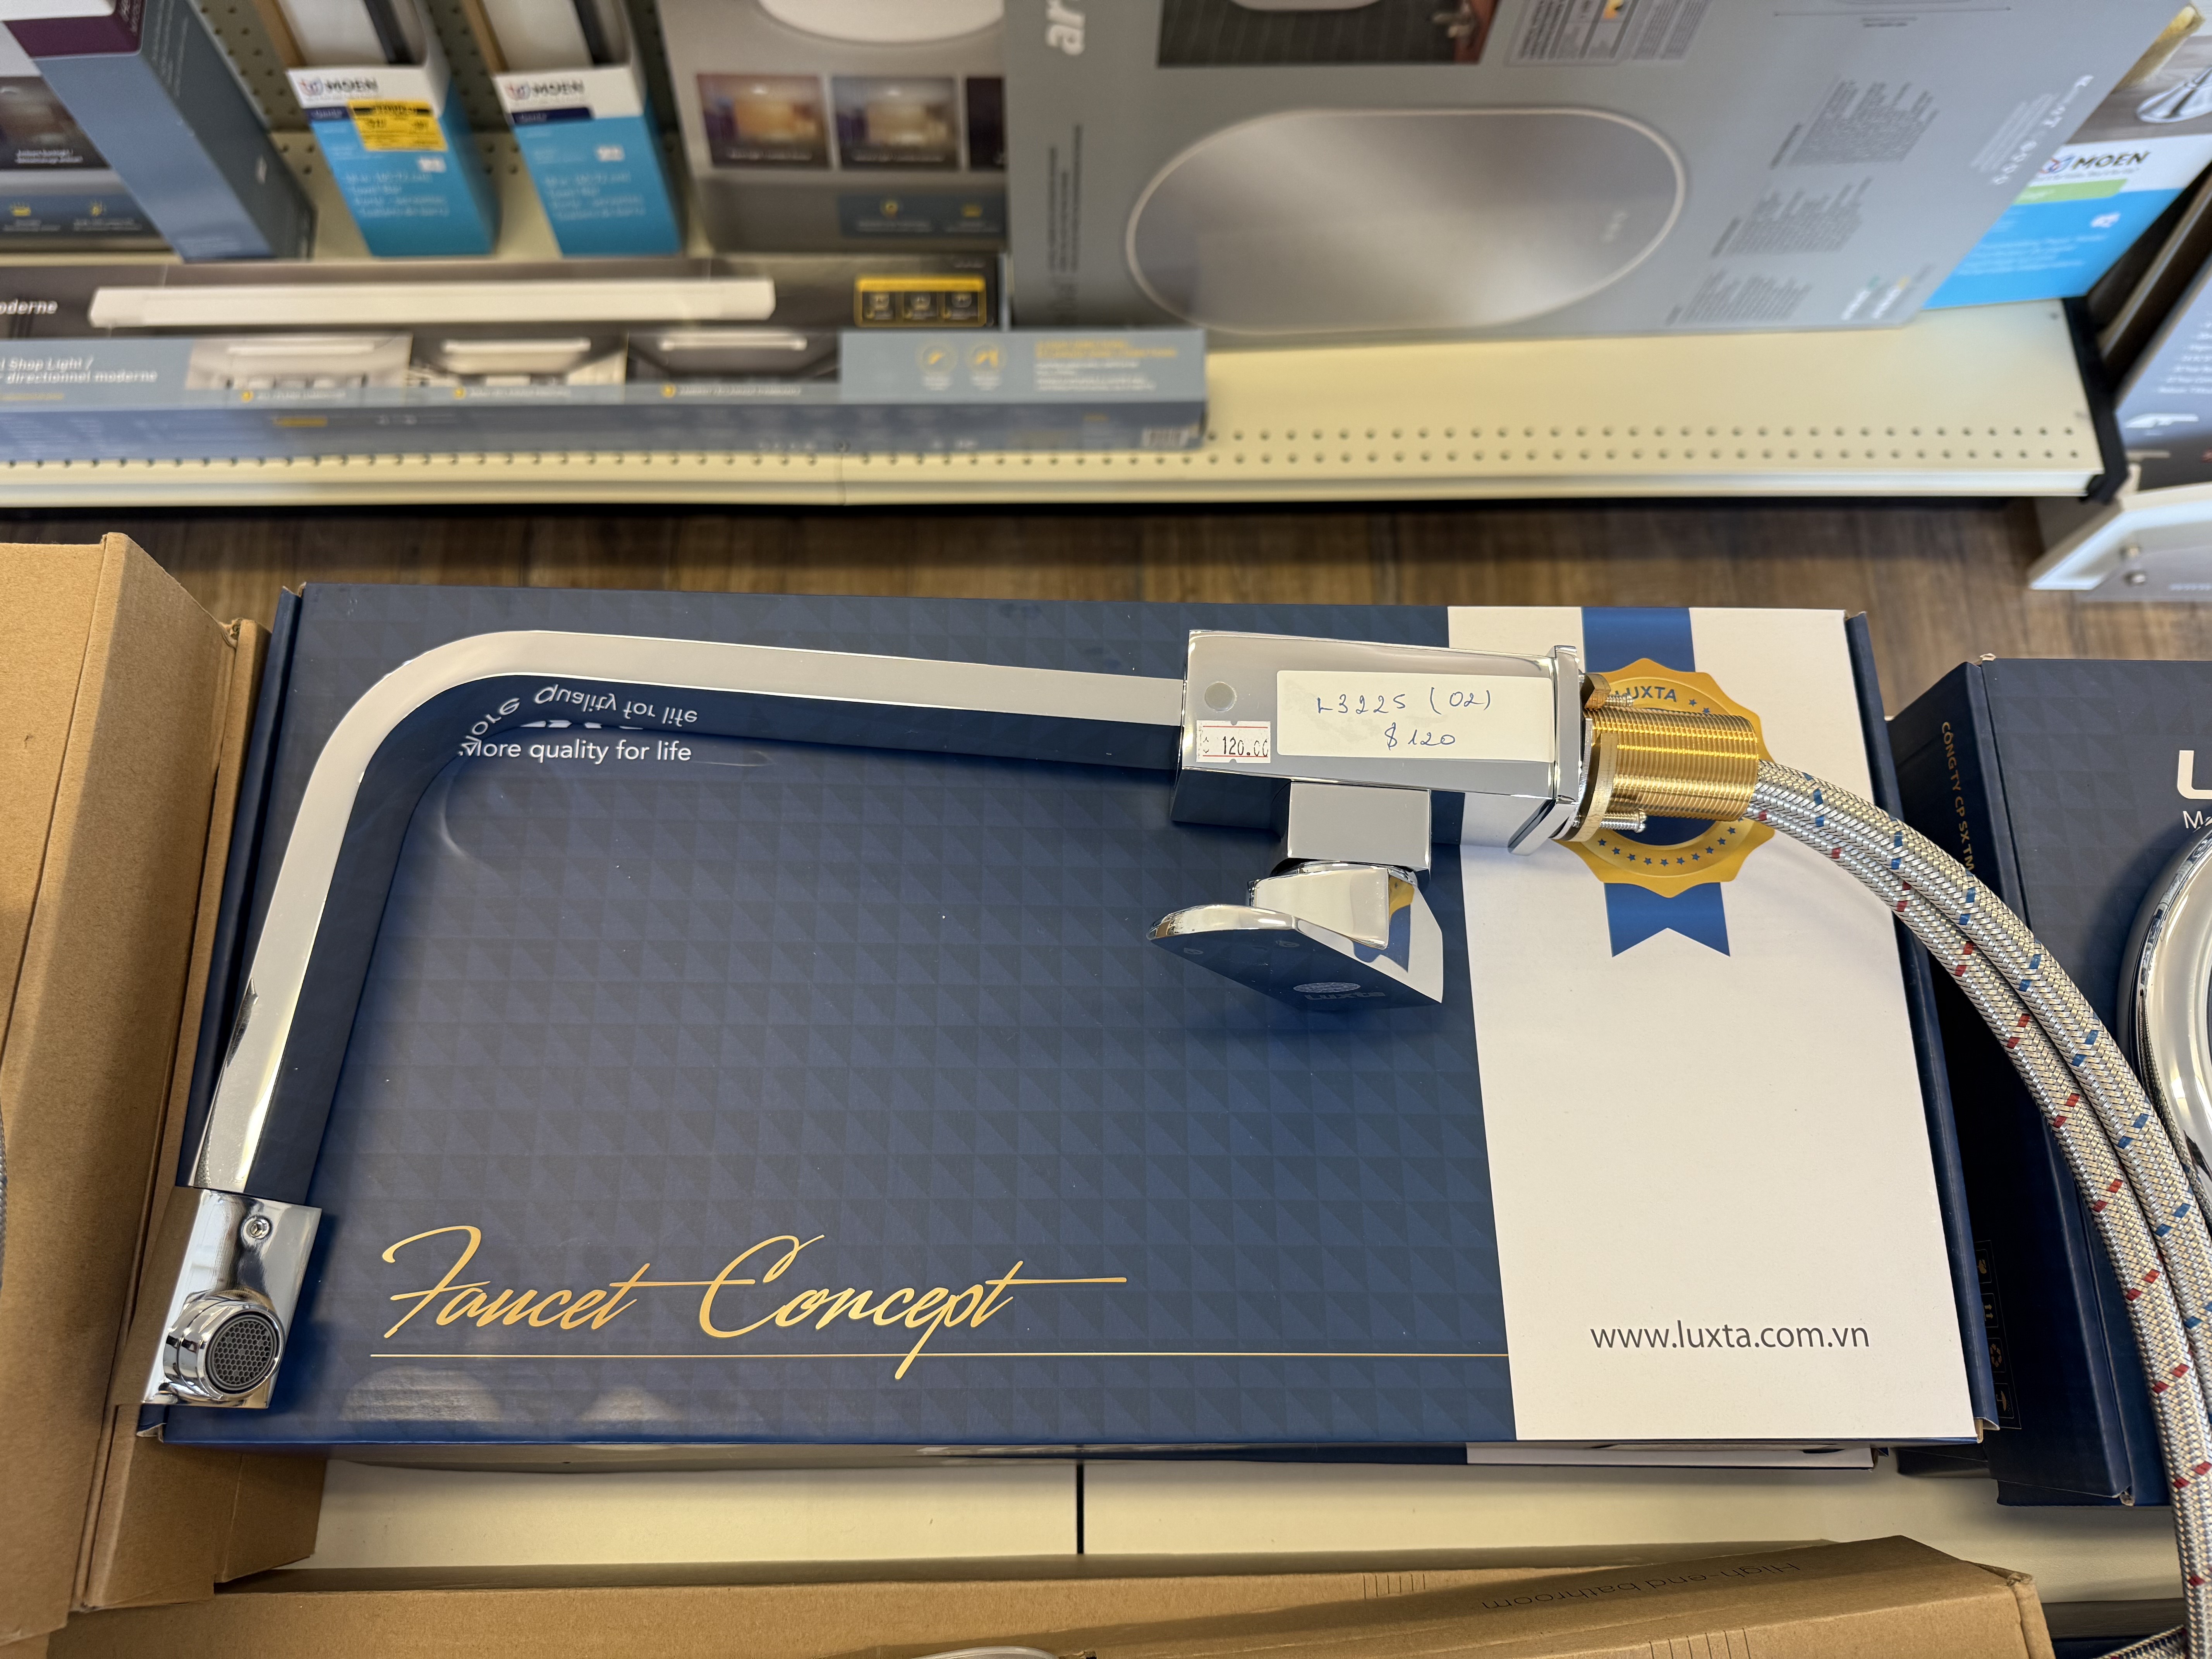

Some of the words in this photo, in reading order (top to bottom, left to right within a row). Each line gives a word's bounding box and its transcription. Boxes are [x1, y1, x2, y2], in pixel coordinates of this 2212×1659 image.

[2072, 150, 2152, 170] MOEN
[530, 739, 609, 764] quality
[617, 739, 649, 758] for
[657, 740, 692, 761] life
[1942, 721, 1957, 770] CÔNG
[1950, 770, 1961, 791] TY
[1955, 796, 1965, 817] CP
[1959, 821, 1970, 844] SX
[381, 1226, 755, 1339] Faucet
[699, 1235, 1127, 1380] Concept
[1590, 1320, 1870, 1348] www.luxta.com.vn
[1481, 1583, 1641, 1609] bathroom
